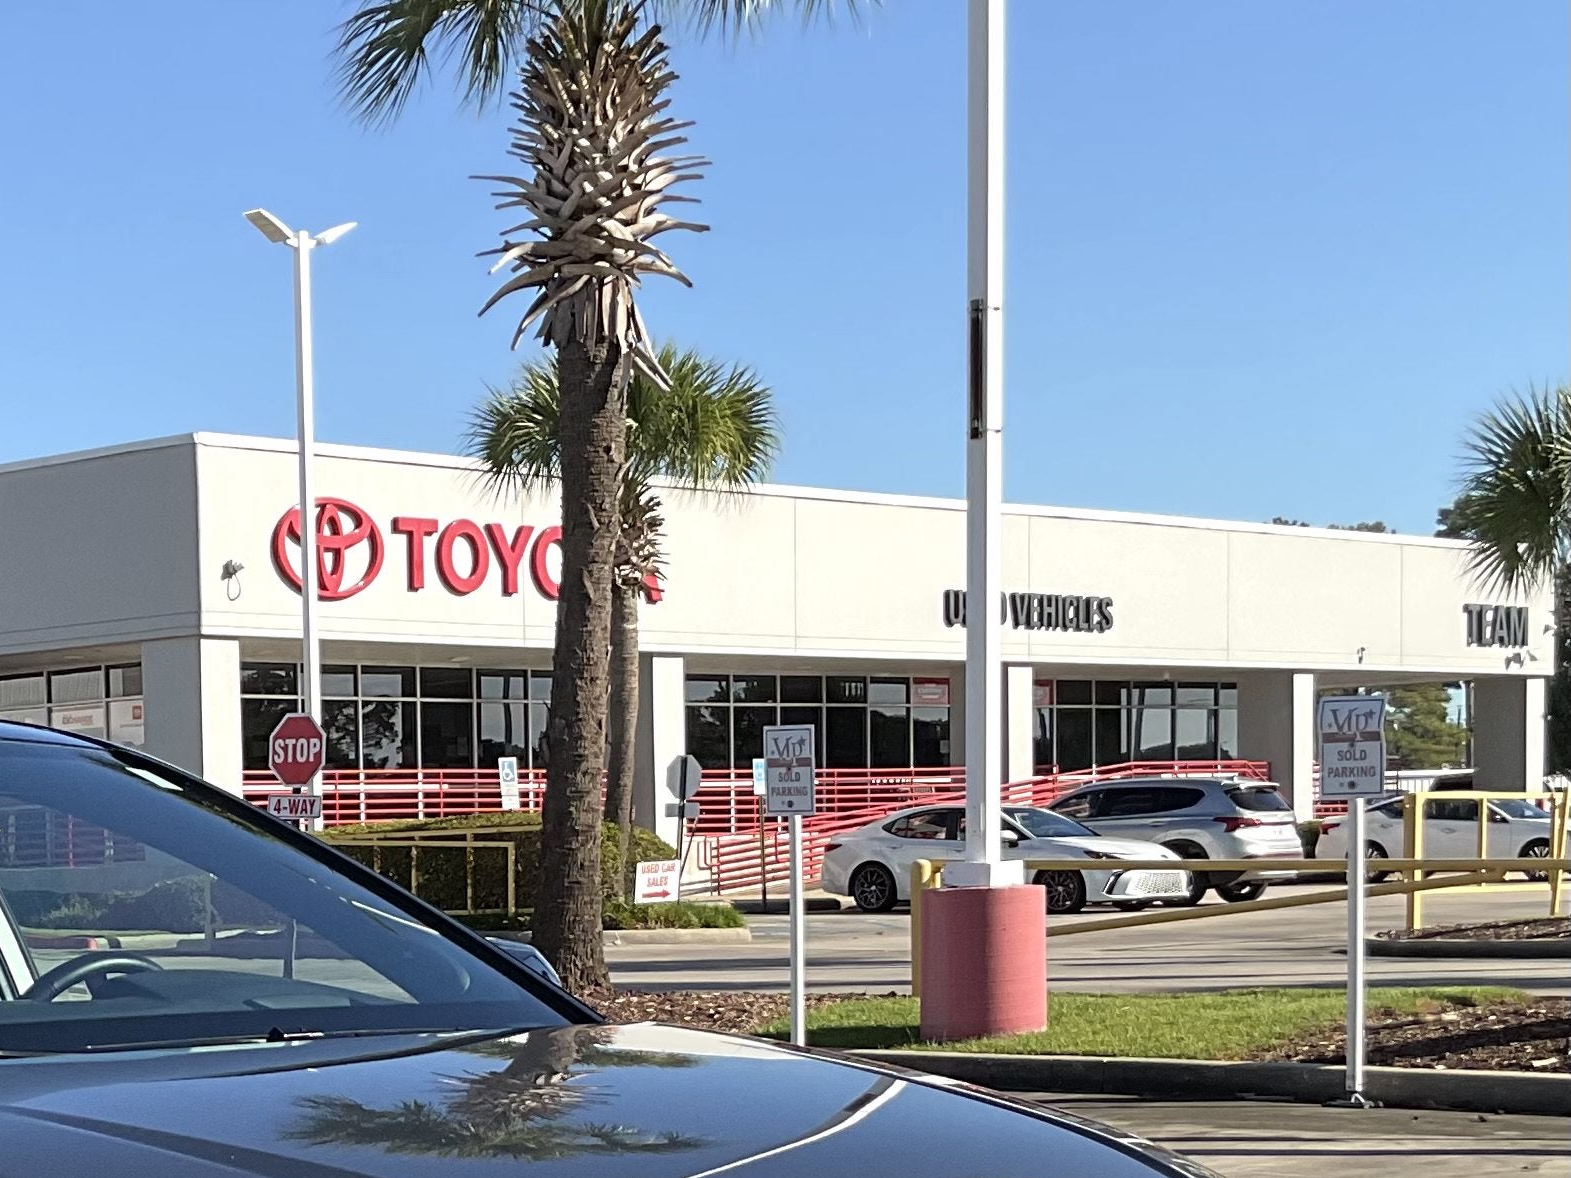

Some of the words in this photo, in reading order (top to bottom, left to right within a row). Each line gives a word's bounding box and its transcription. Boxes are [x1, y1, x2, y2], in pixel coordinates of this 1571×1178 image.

[1009, 592, 1114, 633] VEHICLES
[1462, 603, 1529, 649] TEAM
[273, 738, 321, 763] STOP
[1337, 749, 1367, 762] SOLD
[778, 772, 801, 782] SOLD
[1327, 766, 1376, 778] PARKING
[771, 786, 808, 797] PARKING
[273, 798, 316, 815] 4-WAY
[641, 863, 660, 874] USED
[646, 875, 669, 888] SALES
